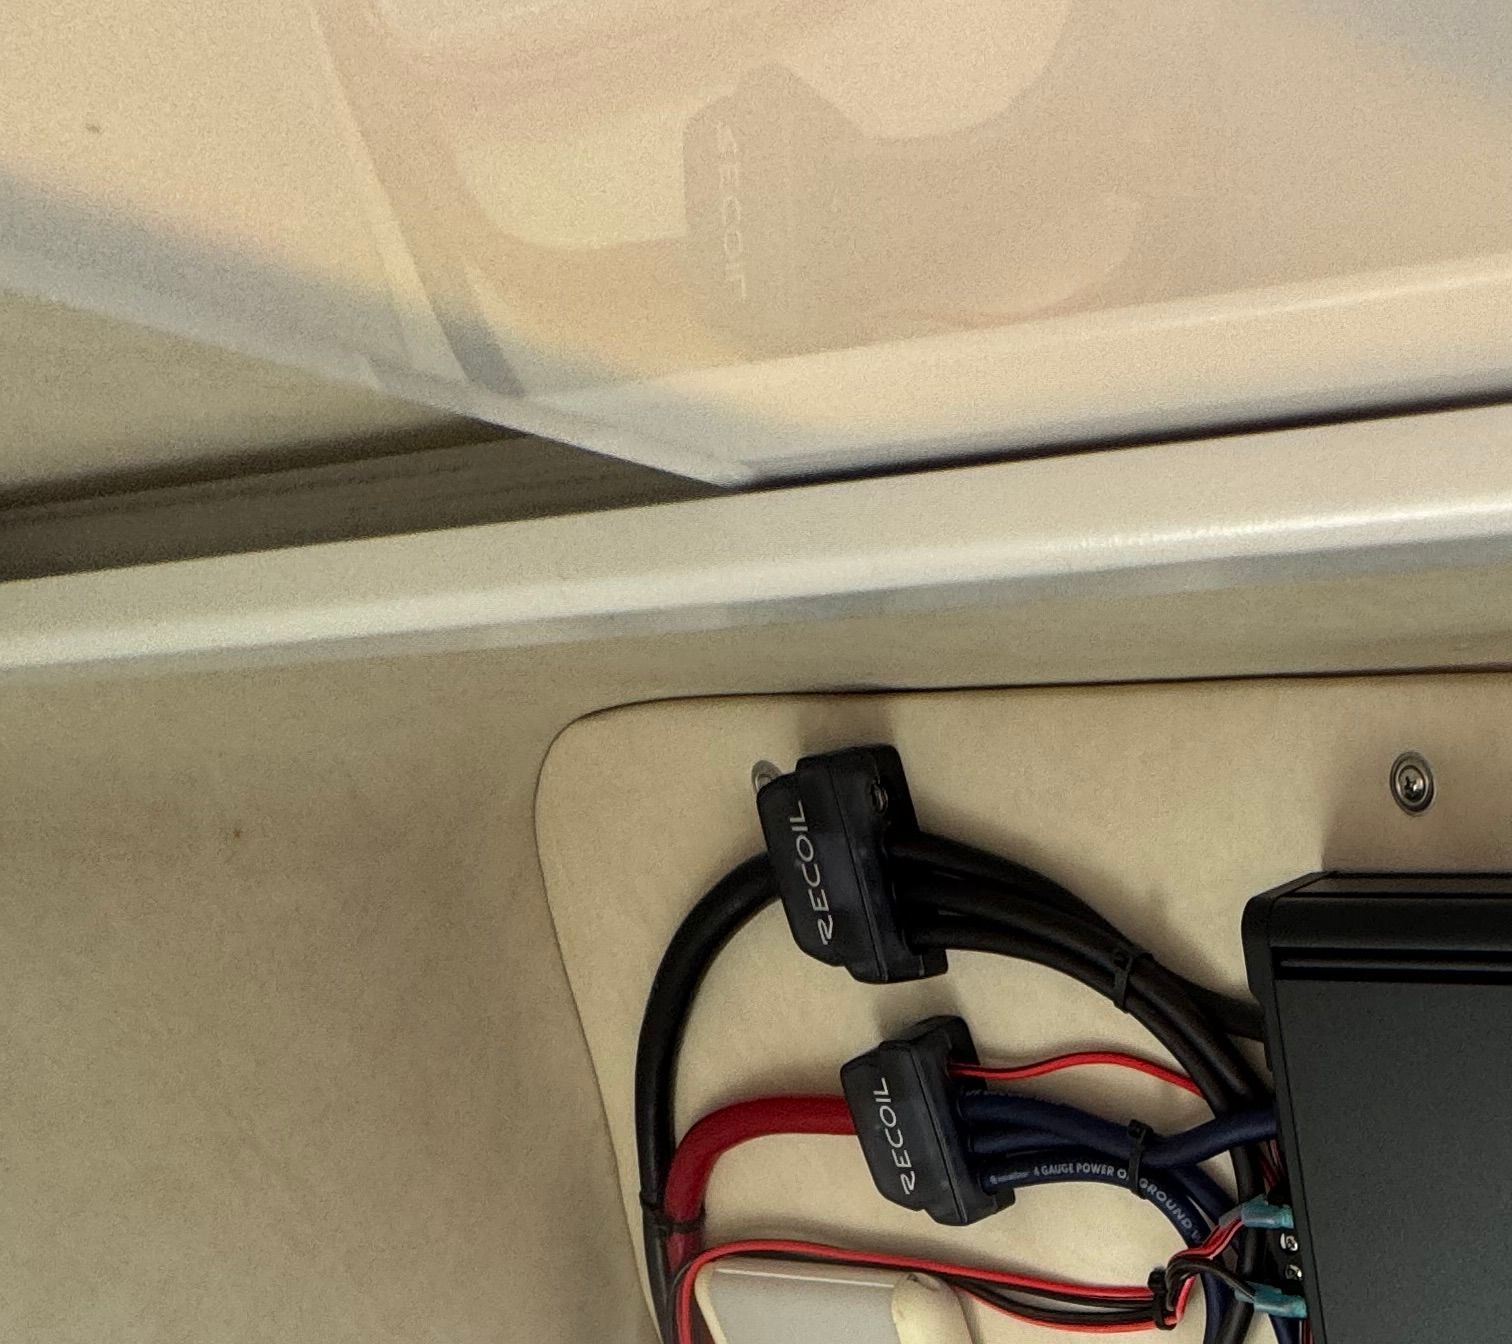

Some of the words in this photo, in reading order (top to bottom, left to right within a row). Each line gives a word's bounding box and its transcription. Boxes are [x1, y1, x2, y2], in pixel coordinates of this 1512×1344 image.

[789, 799, 834, 946] RECOIL
[872, 1077, 916, 1195] RECOIL
[1041, 1163, 1075, 1177] GAUGE
[1075, 1162, 1115, 1177] POWER
[1116, 1168, 1131, 1182] O
[1138, 1176, 1193, 1232] GROUND
